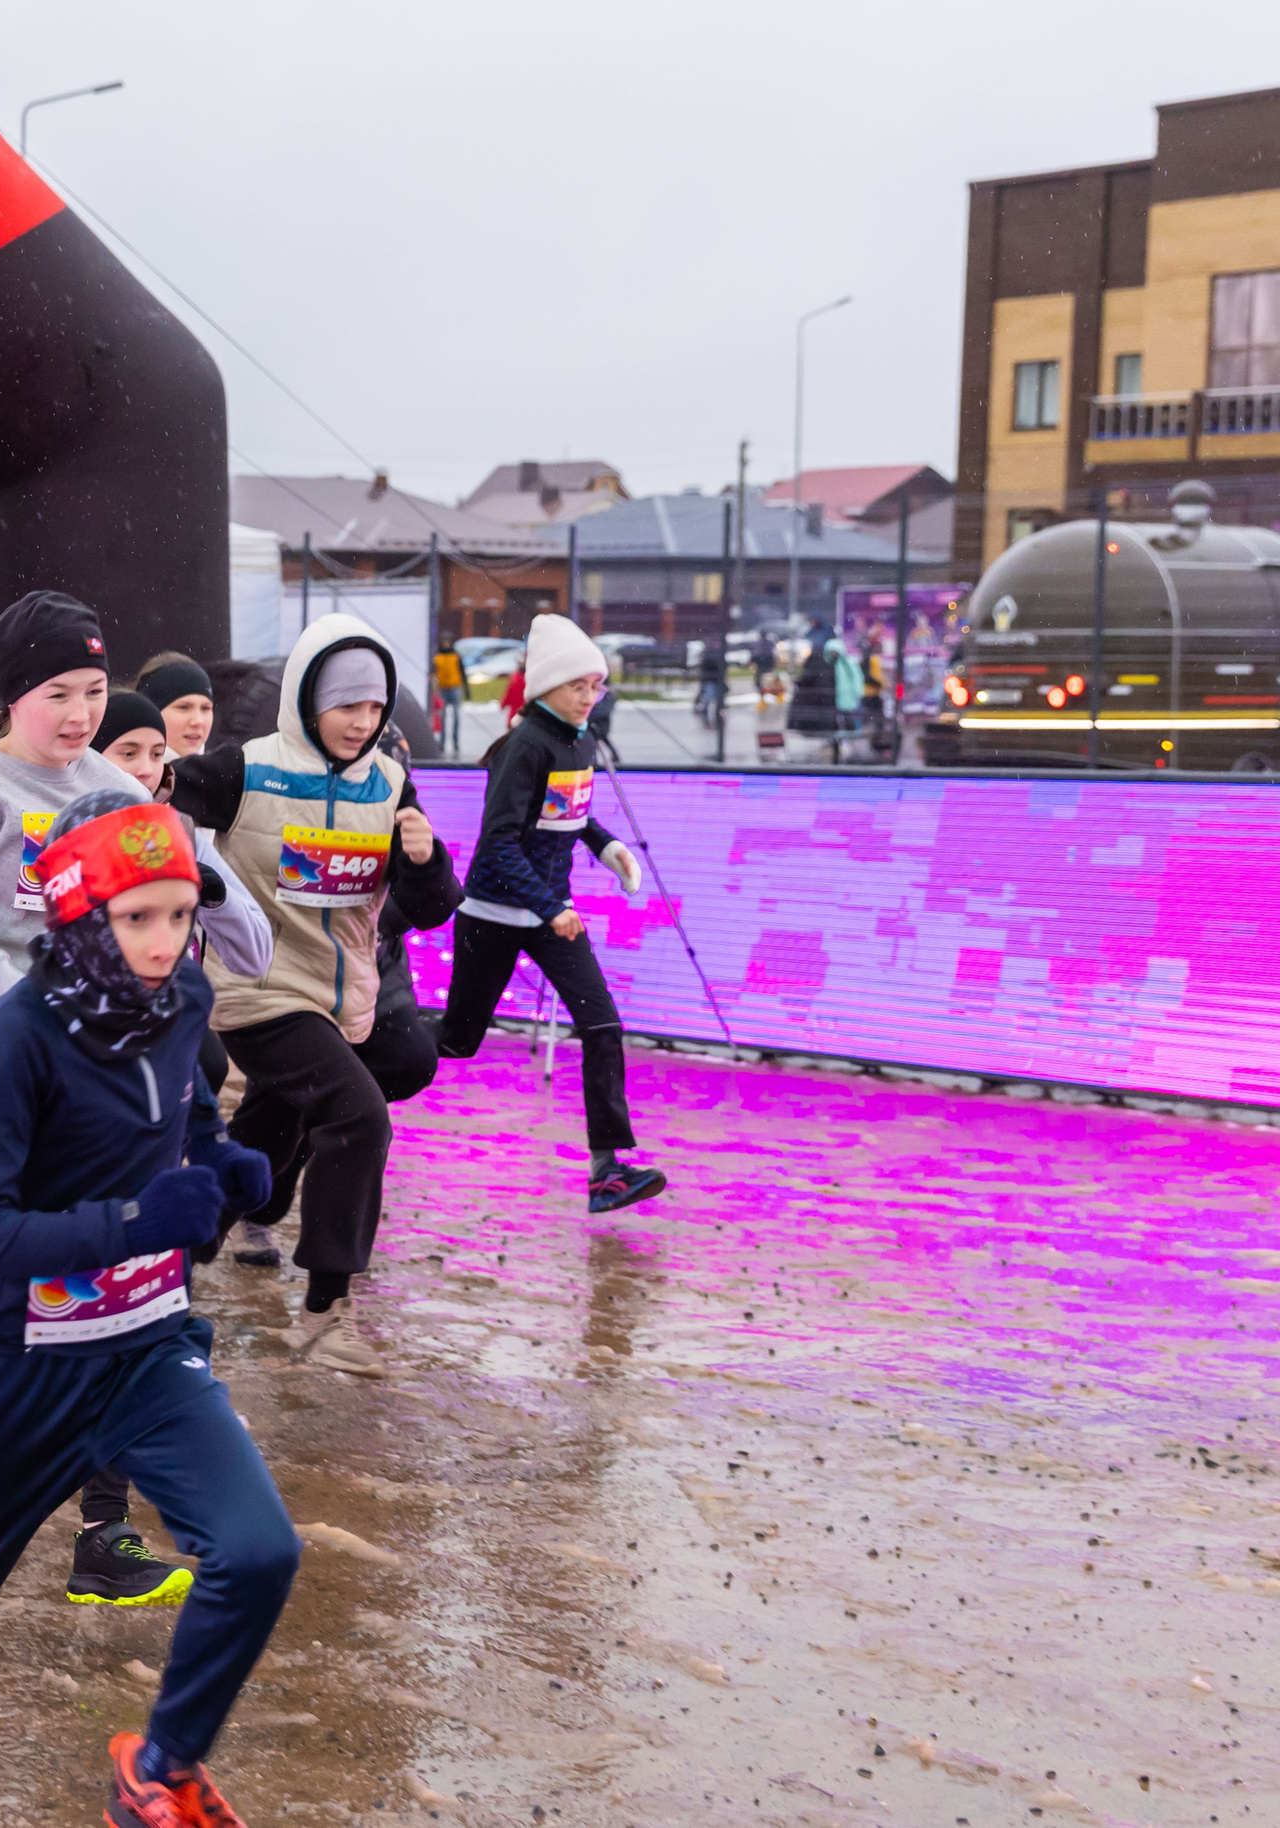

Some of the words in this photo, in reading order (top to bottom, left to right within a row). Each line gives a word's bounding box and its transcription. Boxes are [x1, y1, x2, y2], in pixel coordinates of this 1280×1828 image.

[264, 779, 289, 791] GOLF
[327, 854, 378, 877] 549
[337, 882, 354, 891] 500
